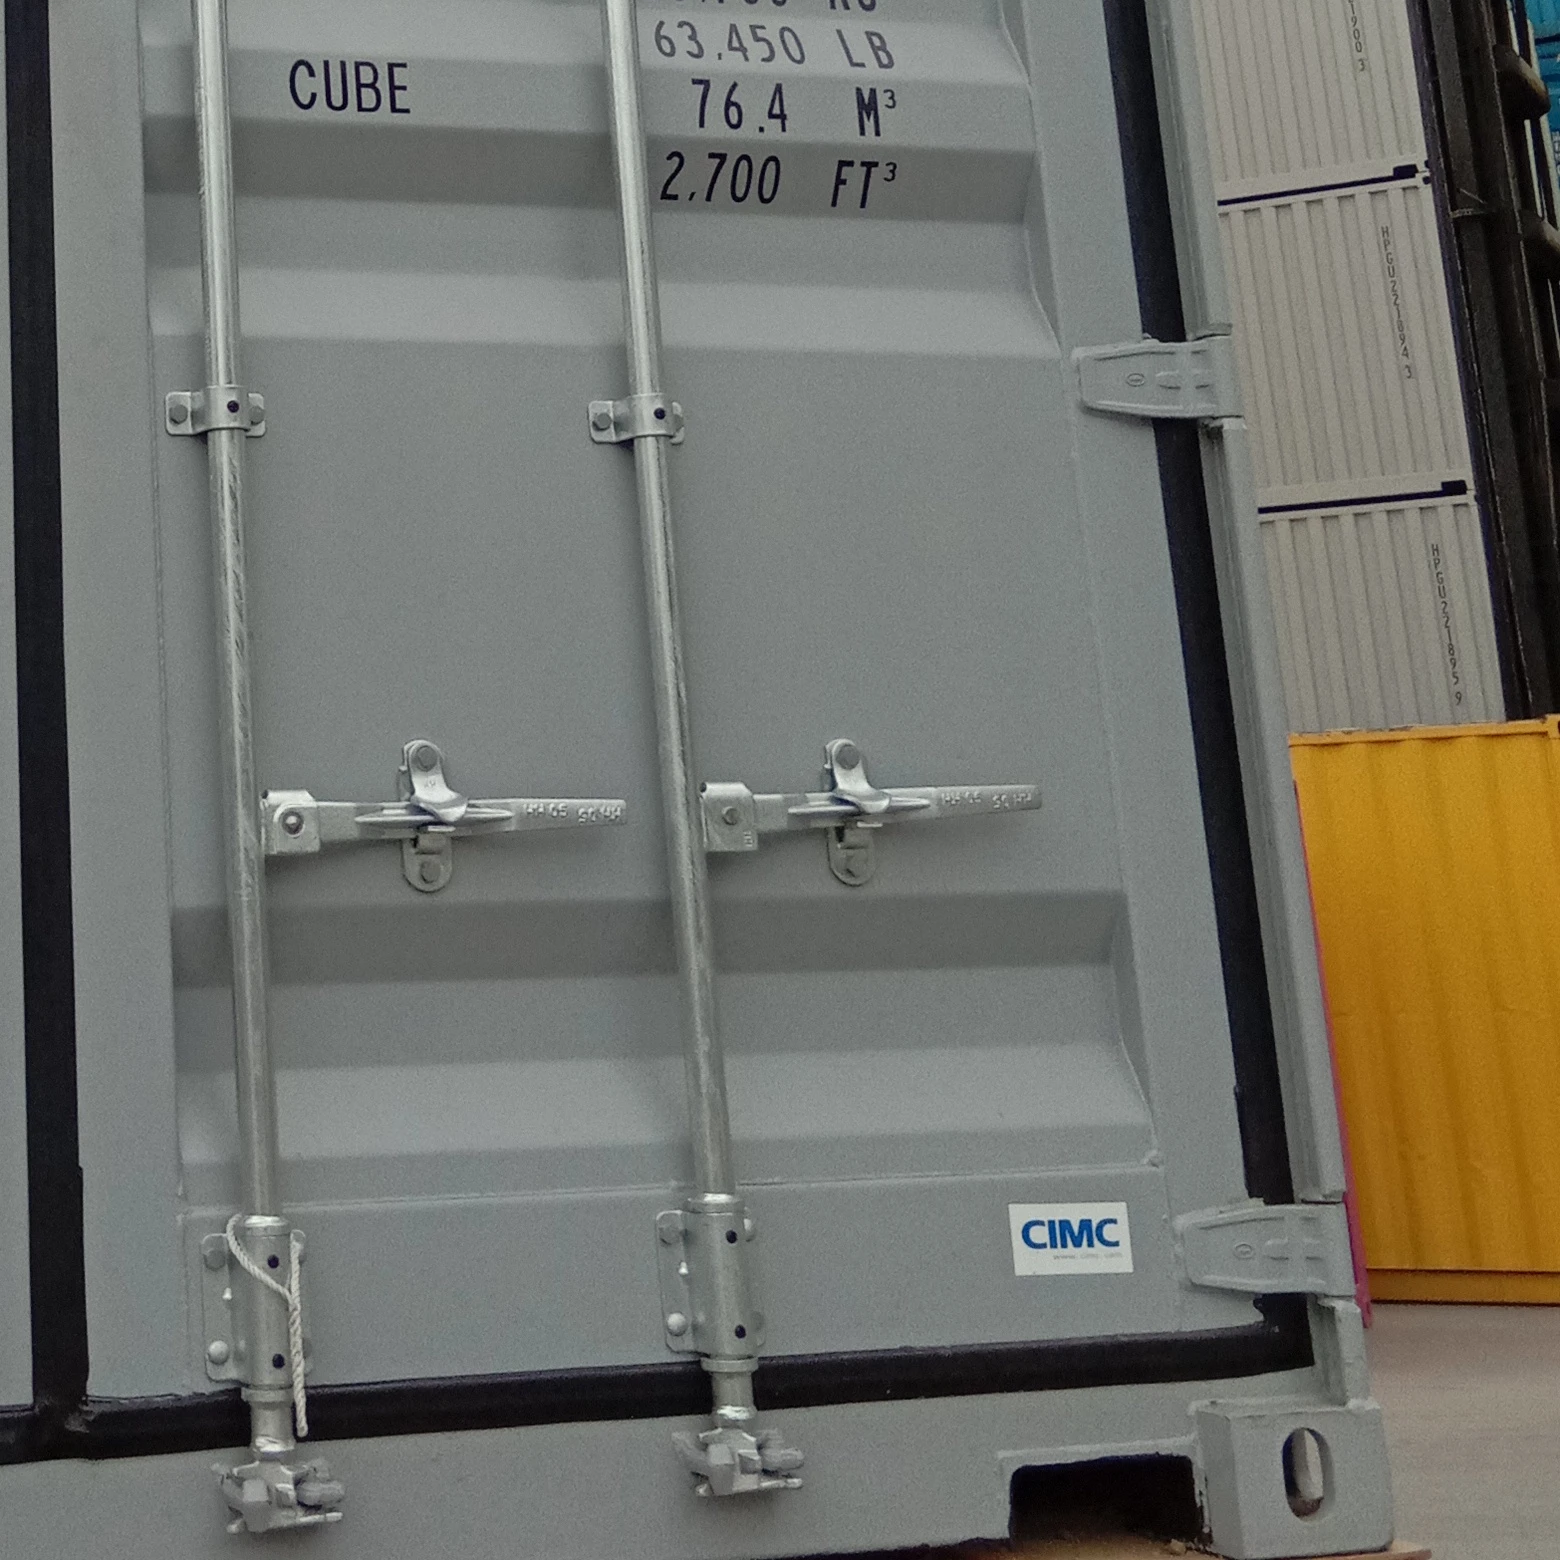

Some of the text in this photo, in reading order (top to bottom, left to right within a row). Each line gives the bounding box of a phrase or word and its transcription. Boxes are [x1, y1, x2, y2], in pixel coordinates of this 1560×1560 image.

[655, 21, 895, 70] 63,450 LB
[289, 59, 412, 115] CUBE
[691, 78, 788, 134] 76.4
[660, 151, 781, 205] 2,700
[1021, 1218, 1120, 1250] CIMC
